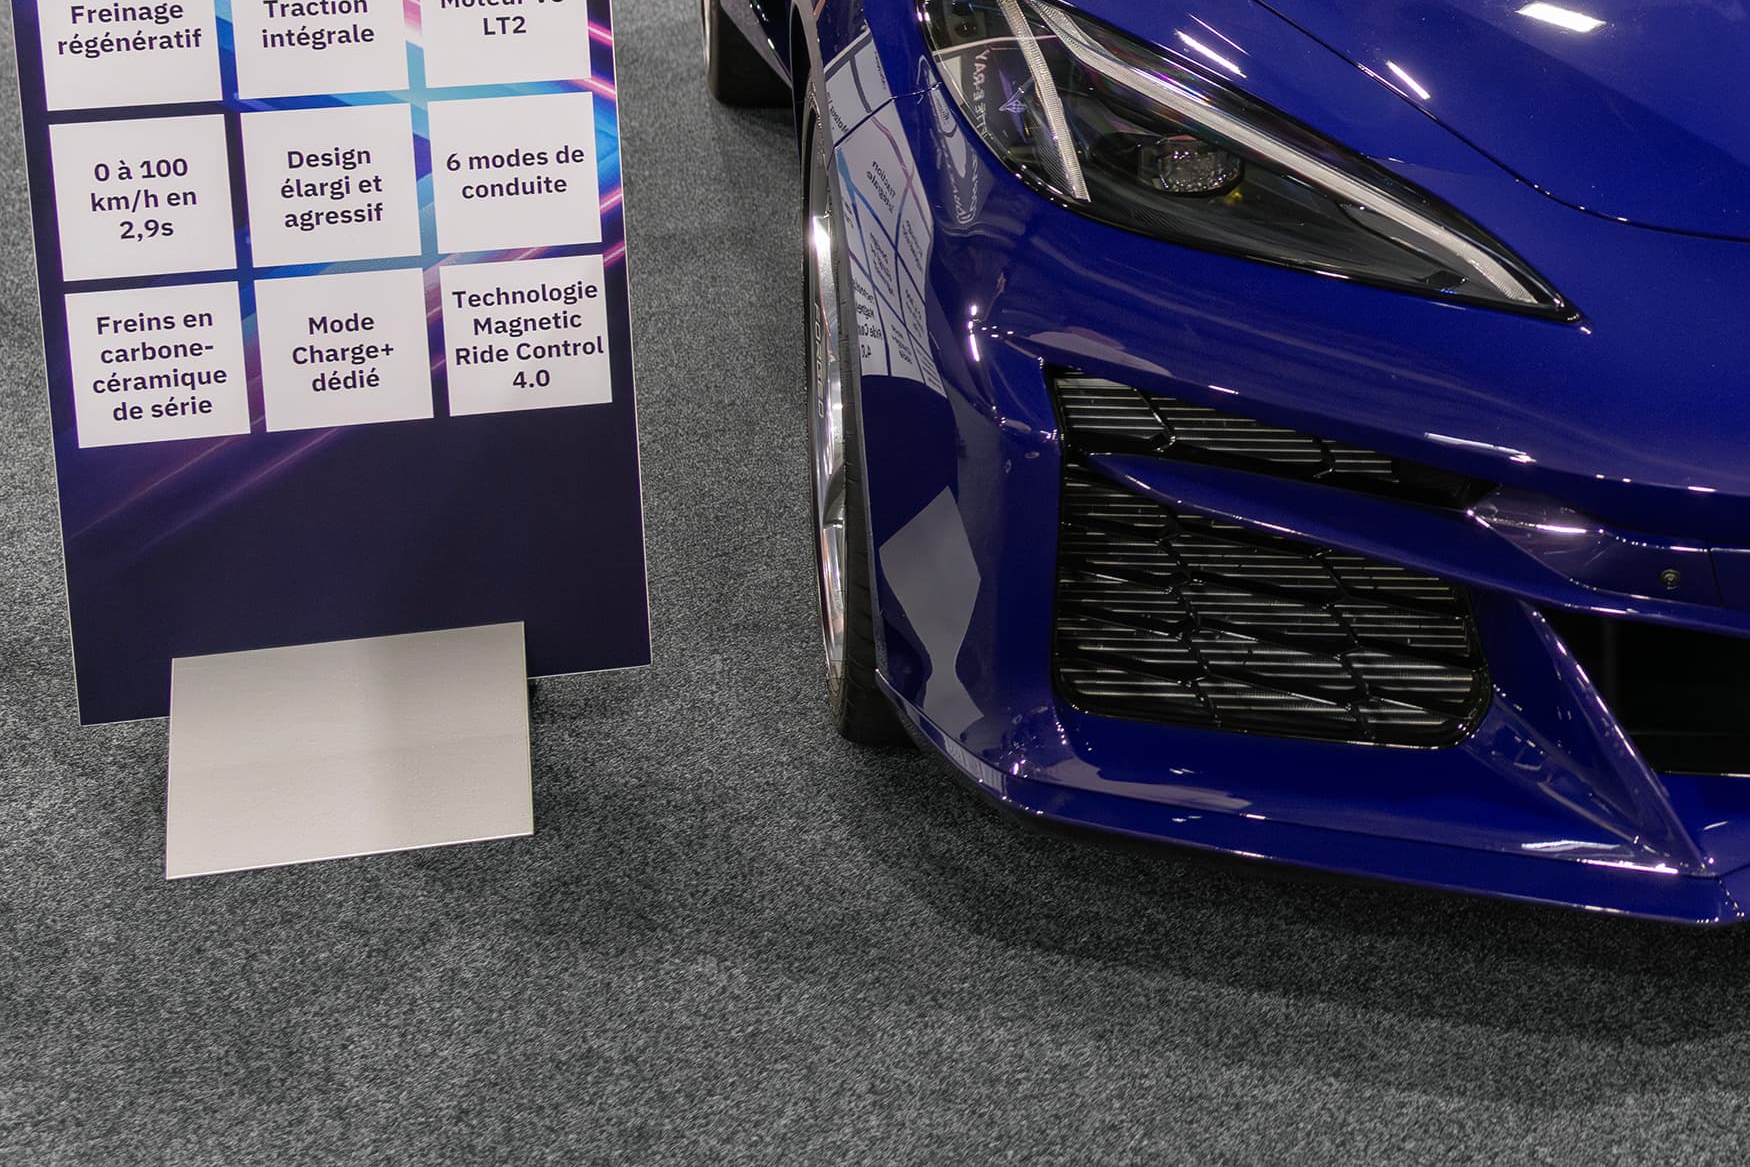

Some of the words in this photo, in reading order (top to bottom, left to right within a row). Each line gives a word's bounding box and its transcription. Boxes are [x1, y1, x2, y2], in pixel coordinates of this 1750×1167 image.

[70, 2, 184, 25] Freinage
[483, 15, 527, 36] LT2
[57, 27, 202, 59] régénératif
[261, 23, 375, 51] intégrale
[94, 163, 110, 182] 0
[117, 159, 133, 181] à
[139, 158, 188, 179] 100
[287, 146, 371, 171] Design
[446, 153, 461, 172] 6
[468, 148, 549, 170] modes
[555, 145, 585, 164] de
[280, 175, 351, 201] élargi
[358, 175, 383, 194] et
[461, 175, 568, 200] conduite
[90, 189, 159, 213] km/h
[166, 191, 197, 207] en
[284, 202, 384, 232] agressif
[119, 219, 174, 242] 2,9s
[451, 280, 598, 309] Technologie
[96, 312, 176, 335] Freins
[183, 312, 213, 328] en
[308, 312, 375, 335] Mode
[473, 310, 582, 338] Magnetic
[100, 341, 214, 364] carbone-
[292, 343, 395, 368] Charge+
[455, 344, 509, 366] Ride
[516, 335, 605, 361] Control
[92, 368, 228, 396] céramique
[311, 367, 380, 392] dédié
[512, 369, 551, 389] 4.0
[113, 401, 144, 422] de
[150, 395, 213, 419] série
